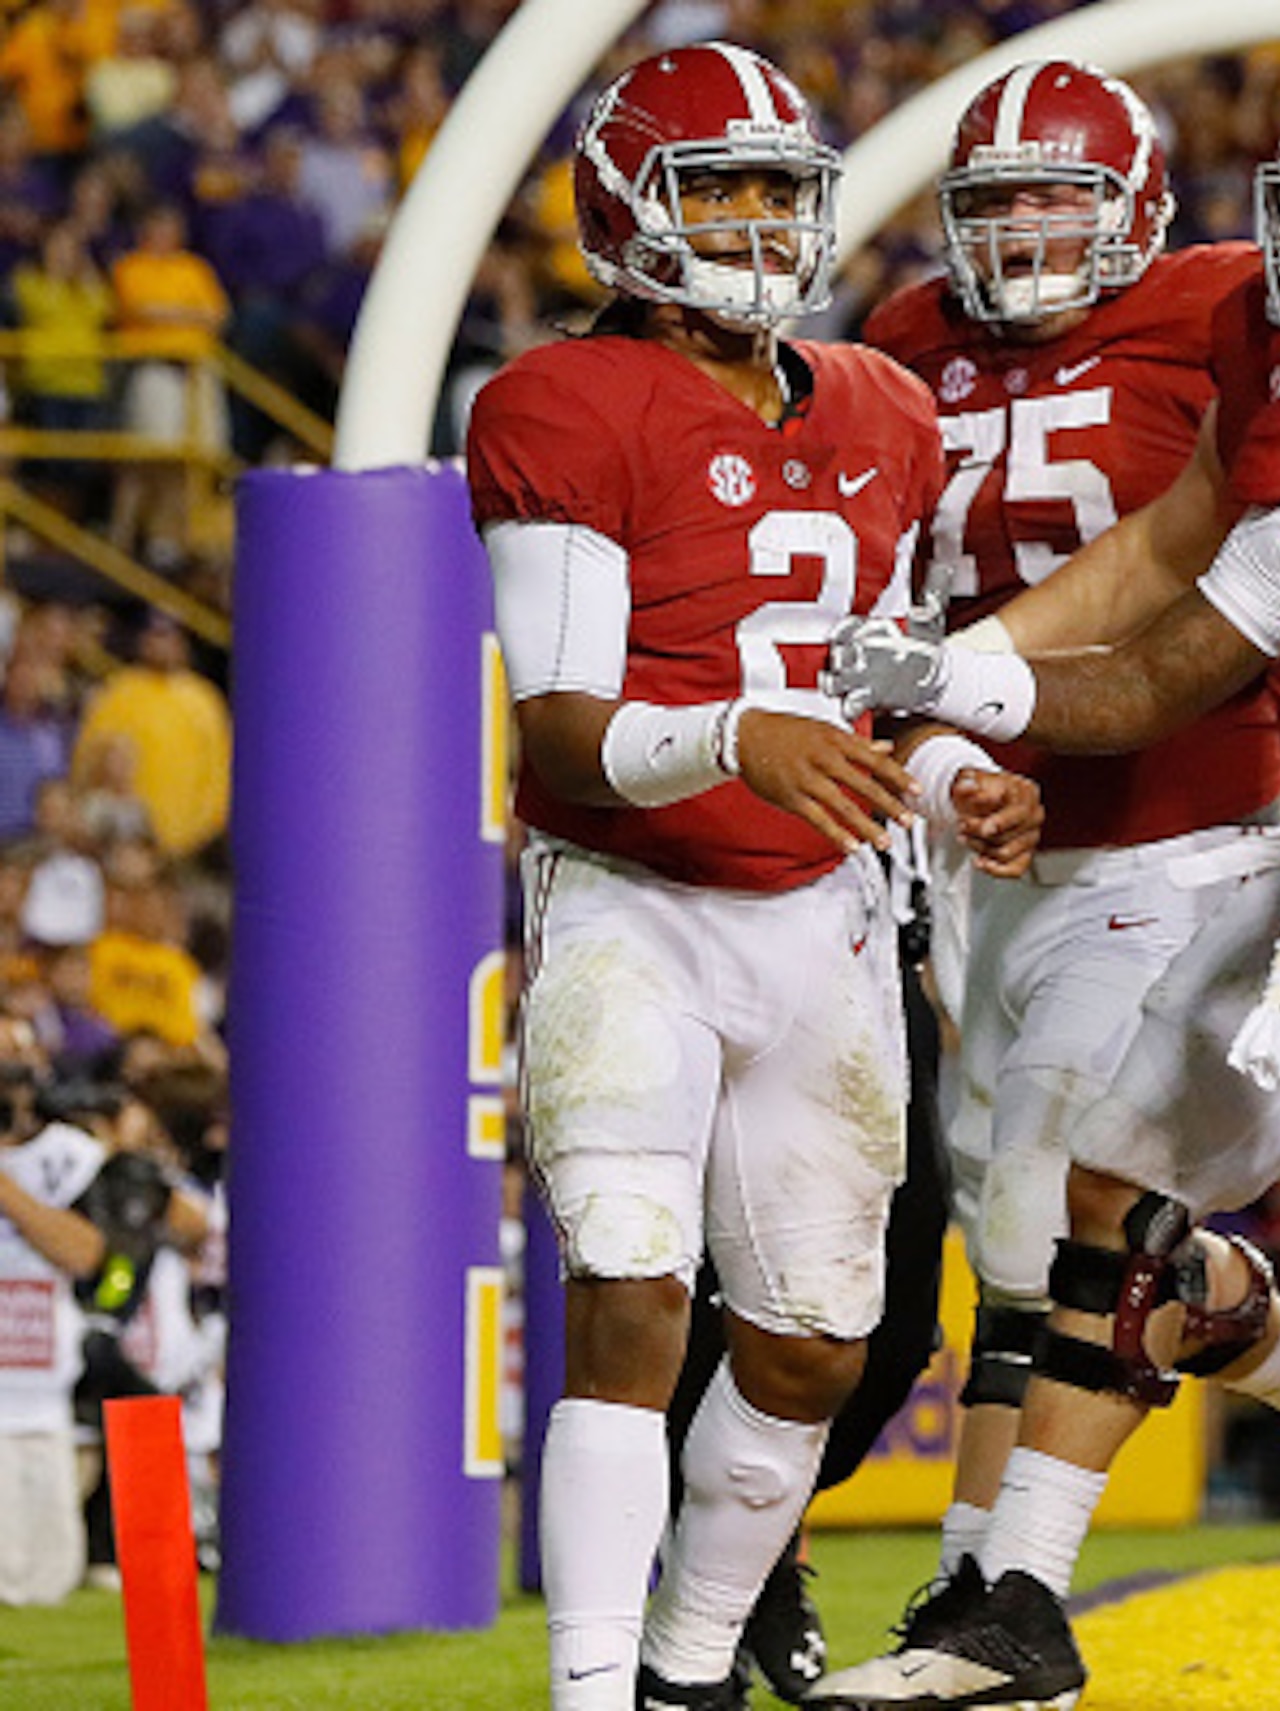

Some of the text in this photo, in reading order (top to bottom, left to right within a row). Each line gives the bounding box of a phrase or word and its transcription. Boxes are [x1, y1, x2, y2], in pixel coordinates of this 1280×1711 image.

[708, 453, 756, 507] SEC
[931, 384, 1119, 598] 75
[734, 509, 859, 715] 2
